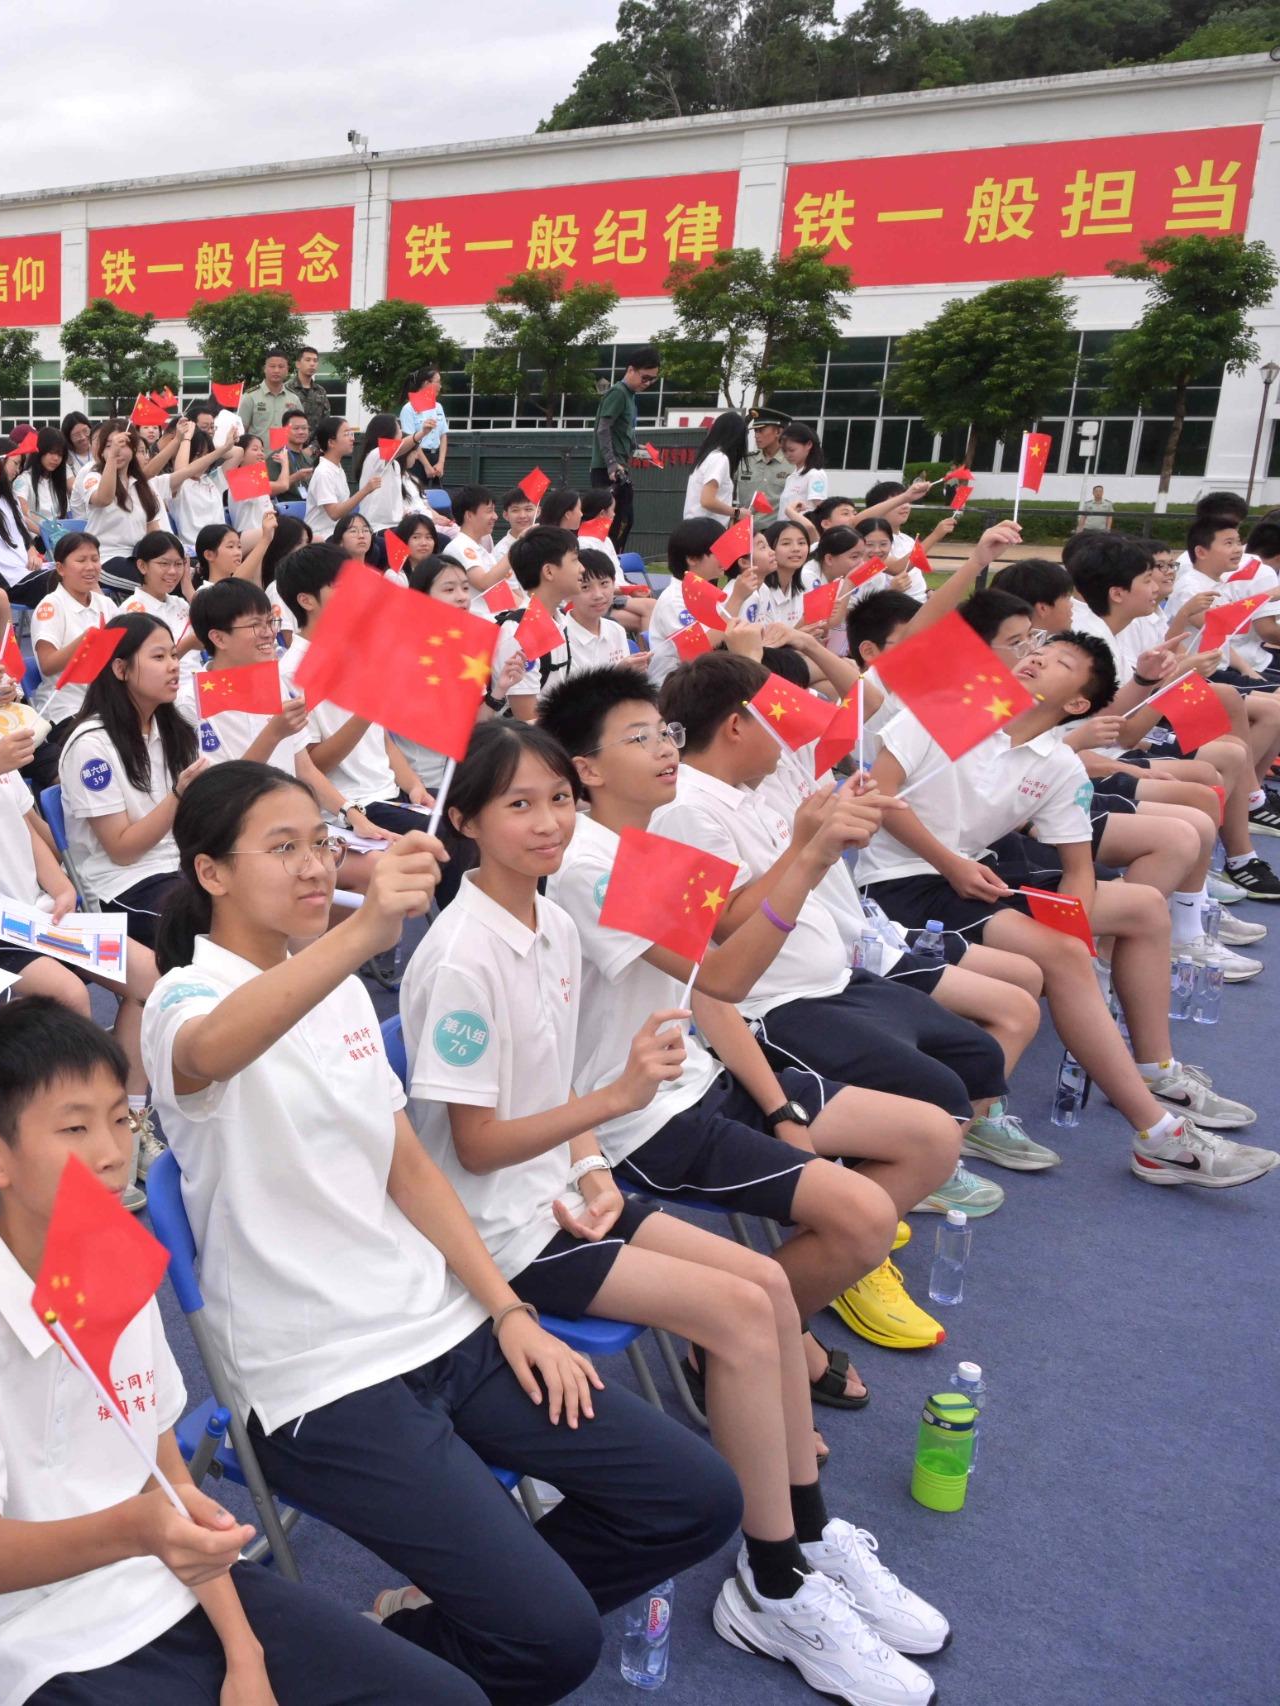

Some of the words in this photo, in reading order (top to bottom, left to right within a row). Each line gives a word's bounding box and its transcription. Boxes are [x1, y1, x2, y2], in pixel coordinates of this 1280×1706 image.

[793, 159, 1241, 252] 铁一般担当
[405, 201, 722, 277] 铁一般纪律
[101, 232, 340, 295] 铁一般信念
[93, 776, 104, 786] 39
[442, 1017, 486, 1046] 第八组
[448, 1040, 467, 1057] 76
